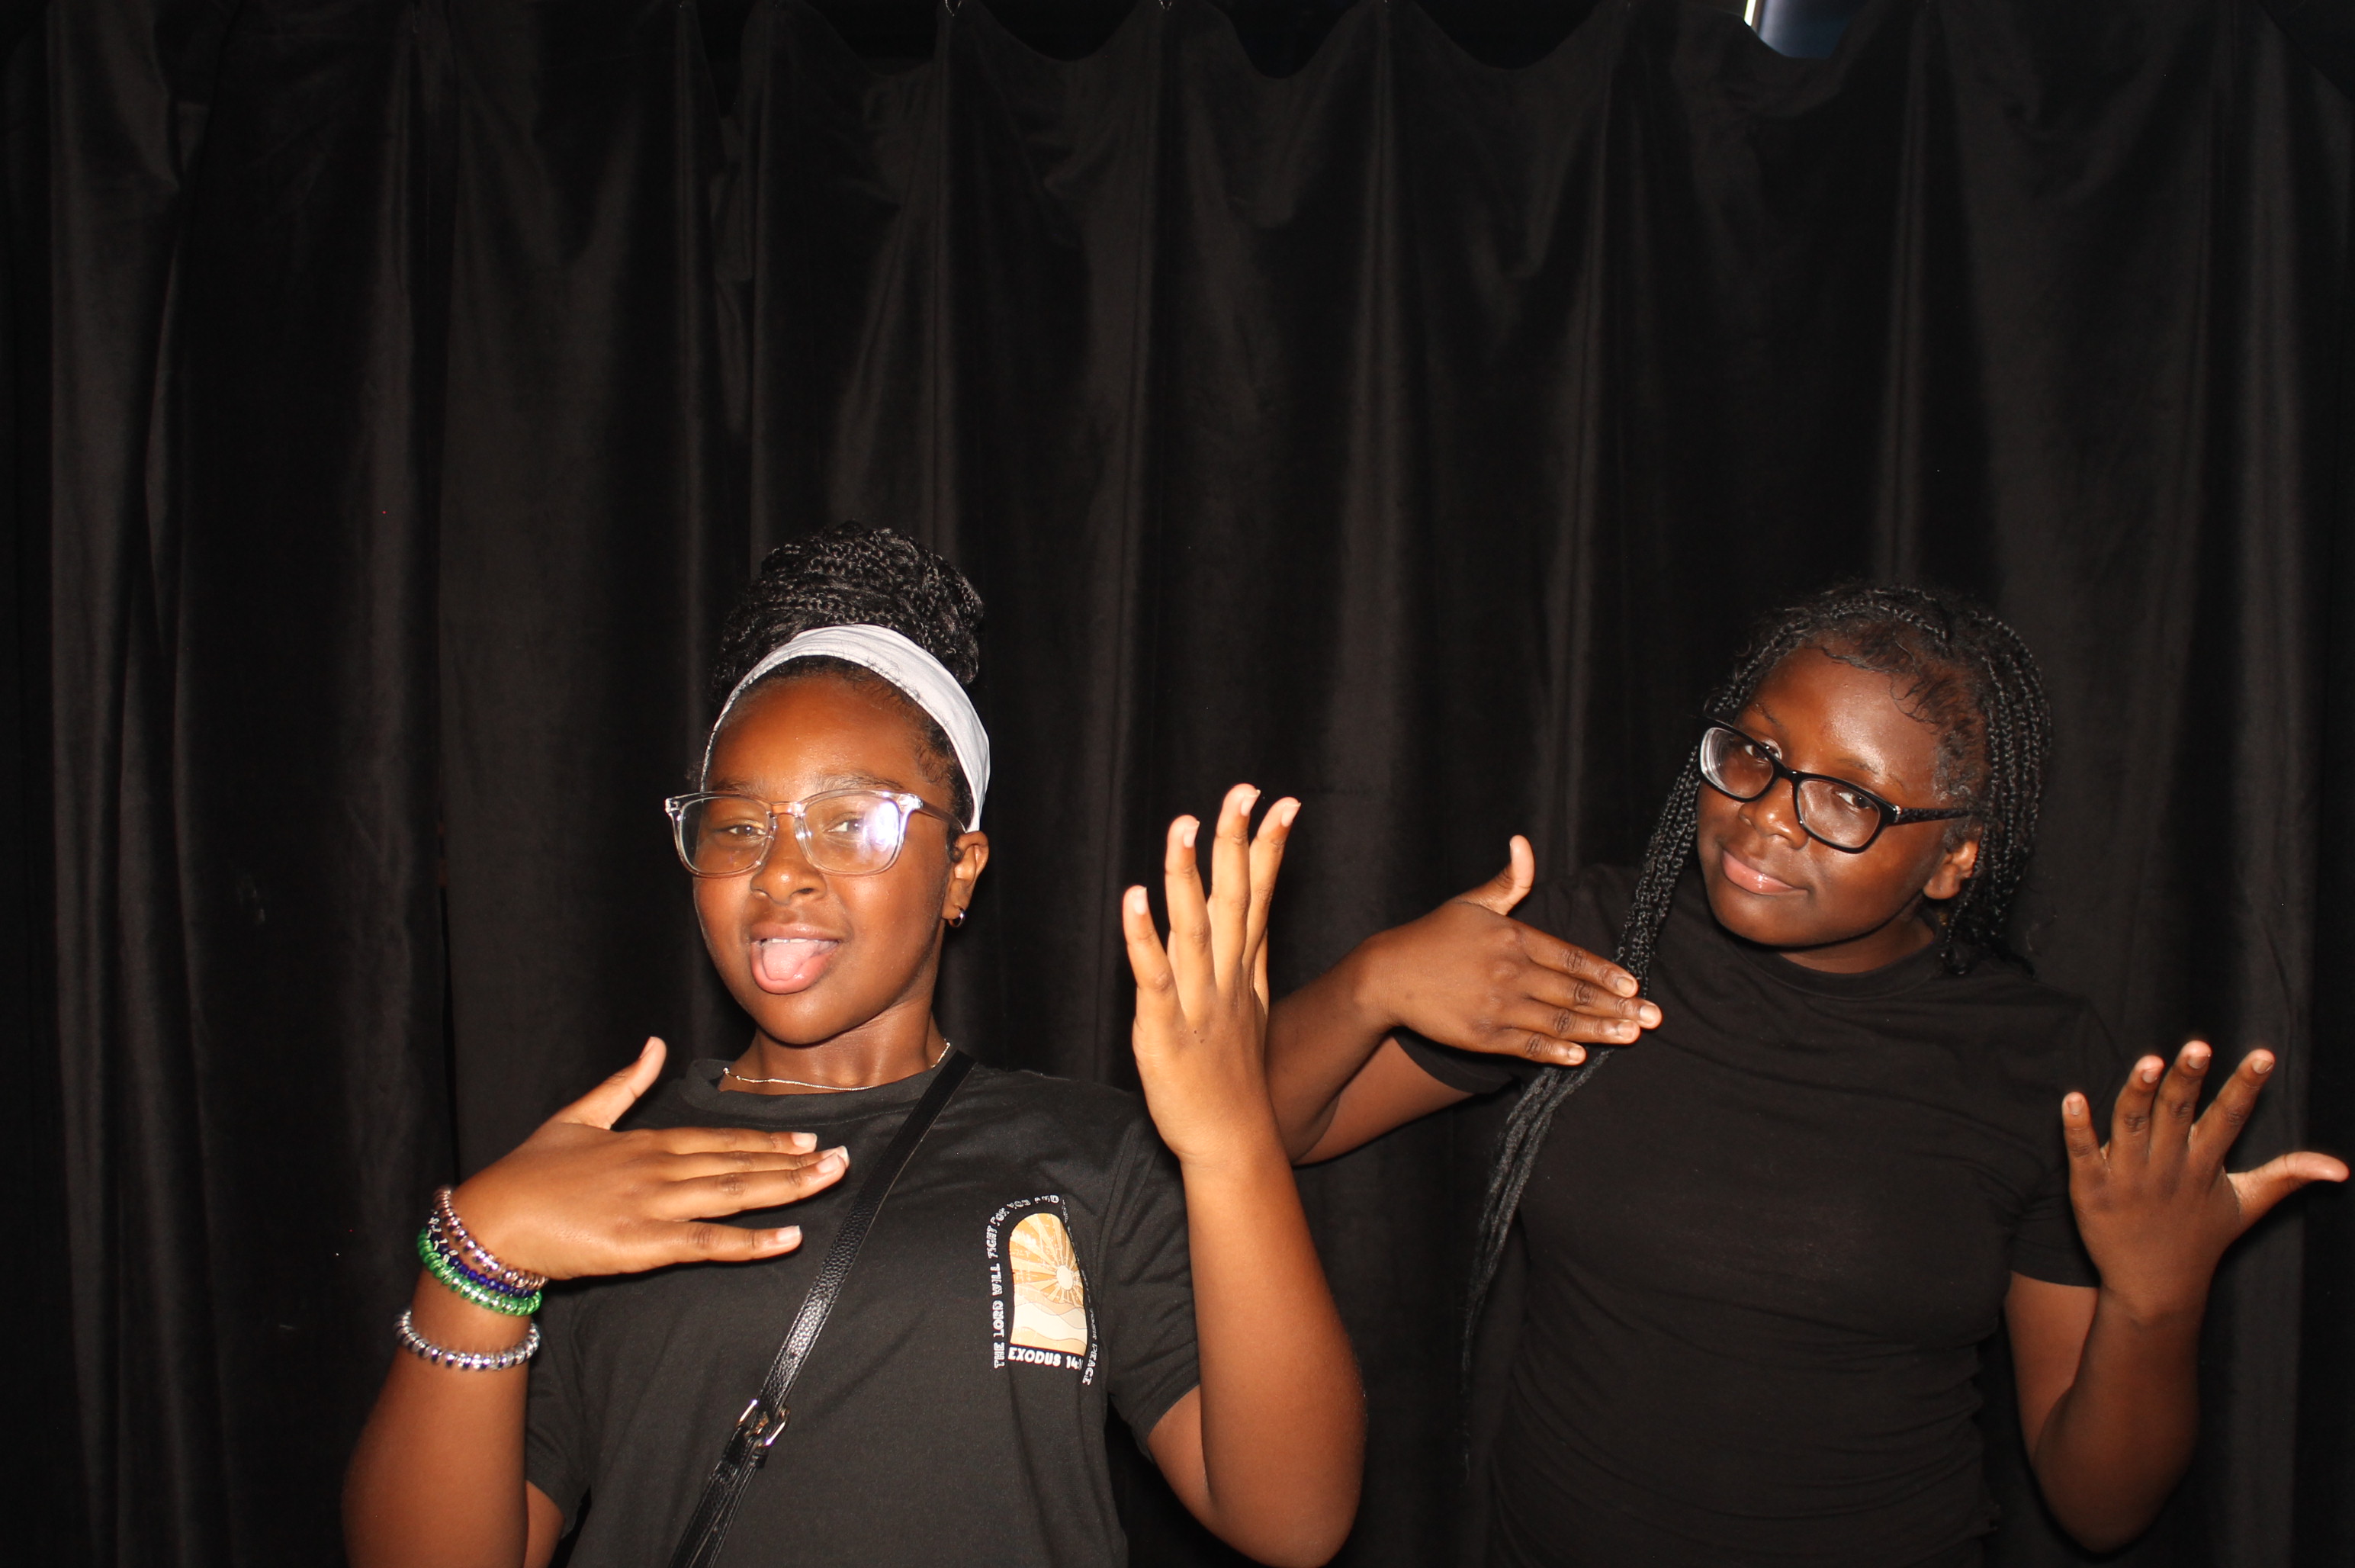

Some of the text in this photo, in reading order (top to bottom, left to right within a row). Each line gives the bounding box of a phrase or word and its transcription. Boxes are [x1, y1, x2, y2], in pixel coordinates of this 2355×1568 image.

[986, 1225, 998, 1259] FIGHT
[990, 1262, 1003, 1296] WILL
[992, 1300, 1005, 1338] LORD
[994, 1342, 1005, 1369] THE
[1007, 1346, 1062, 1367] EXODUS
[1081, 1343, 1098, 1386] PEACE
